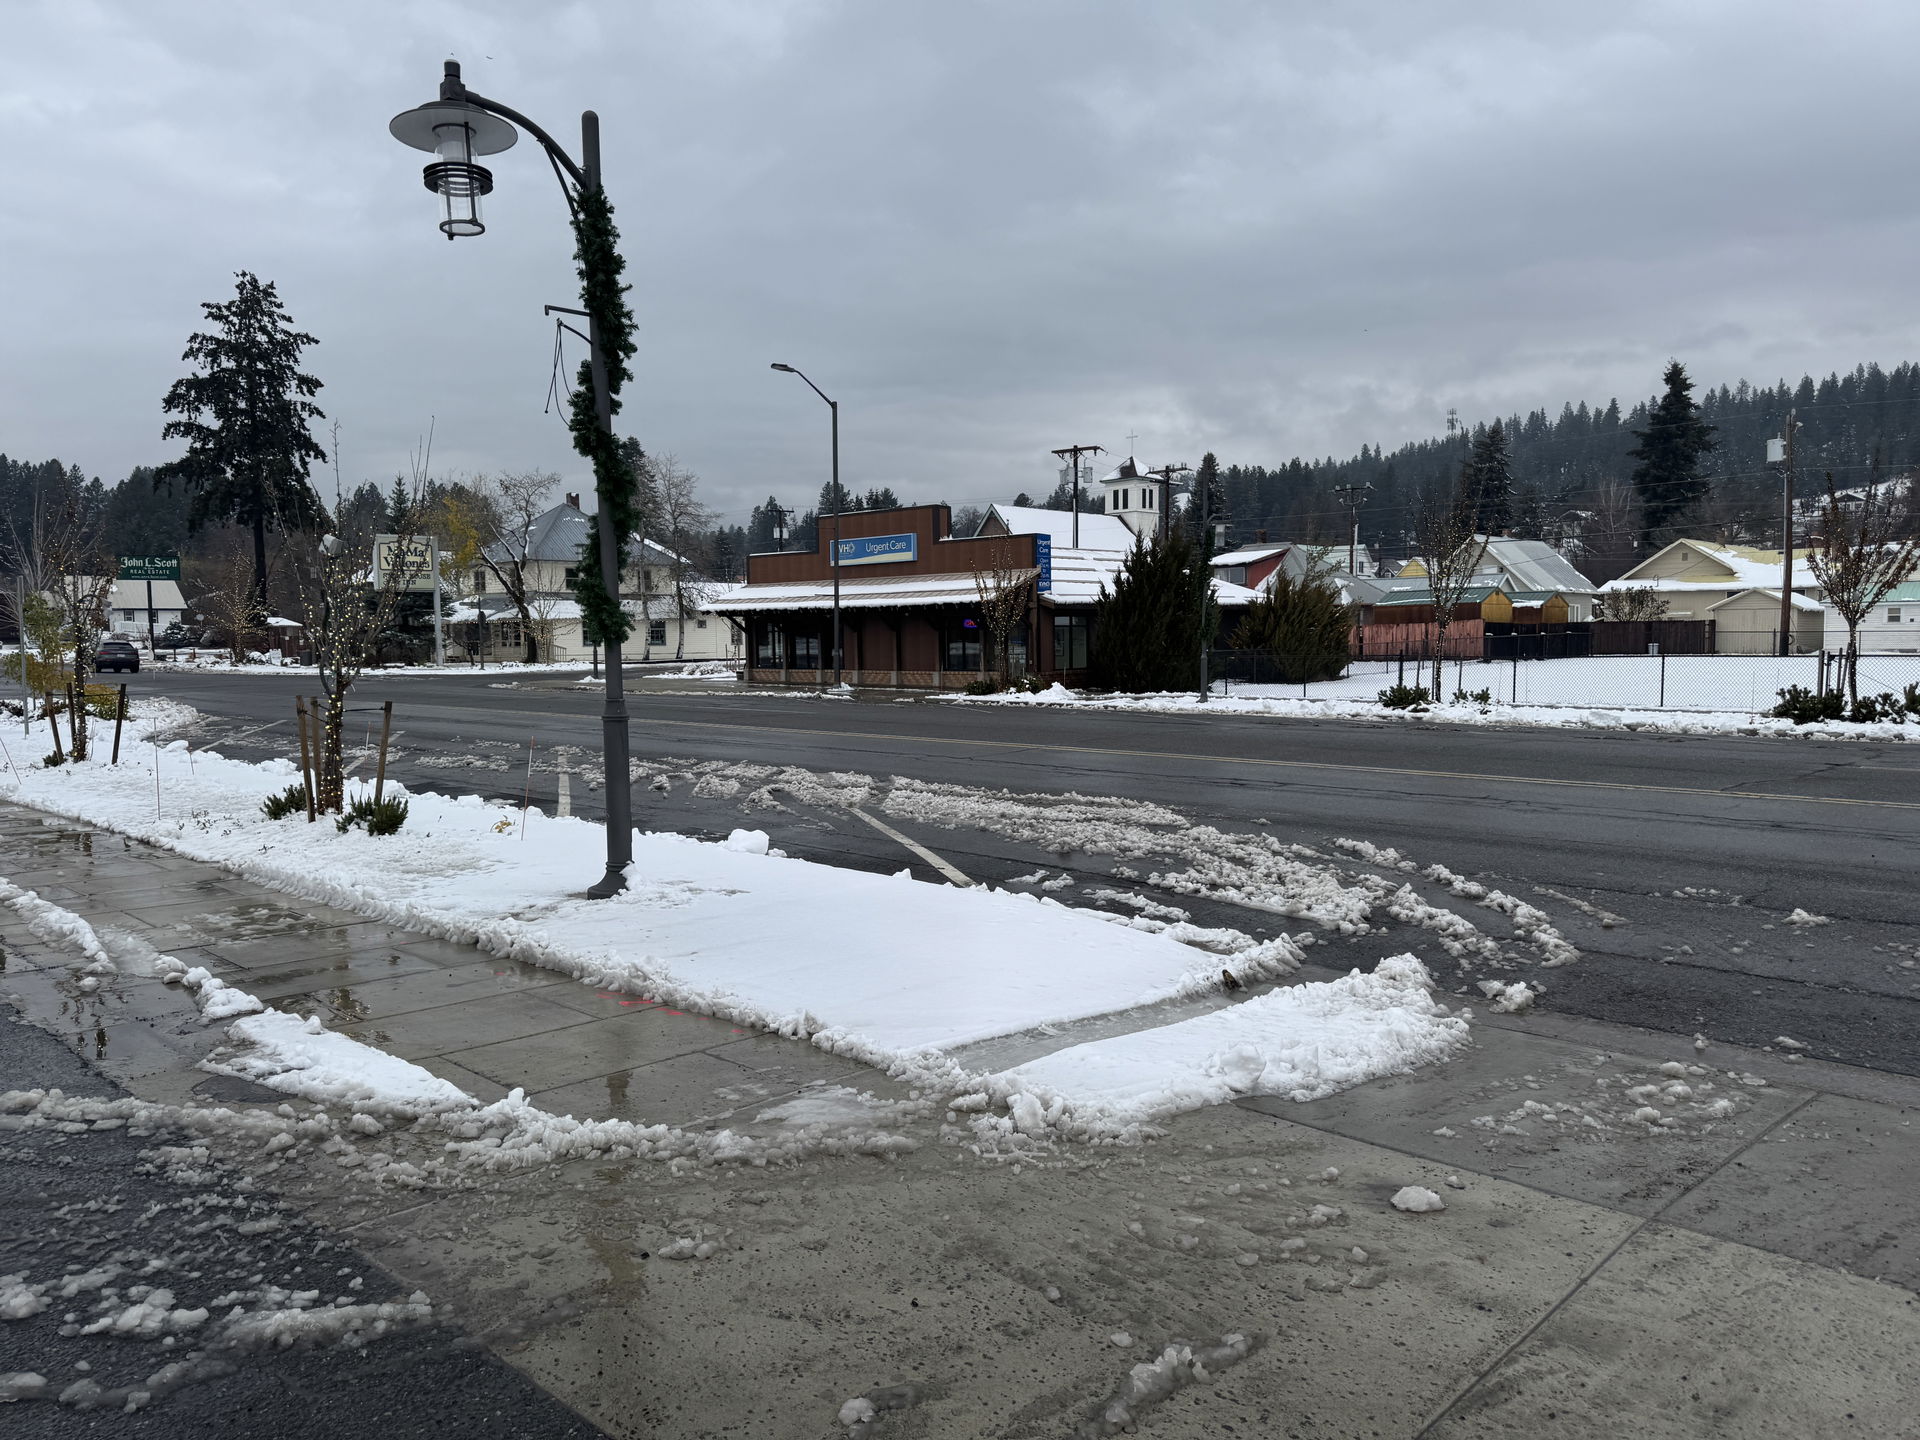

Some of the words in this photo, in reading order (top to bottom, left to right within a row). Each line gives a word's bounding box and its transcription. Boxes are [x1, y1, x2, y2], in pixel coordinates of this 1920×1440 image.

[865, 543, 889, 553] Urgent
[889, 540, 906, 550] Care
[120, 556, 143, 568] John
[154, 557, 178, 568] Scott
